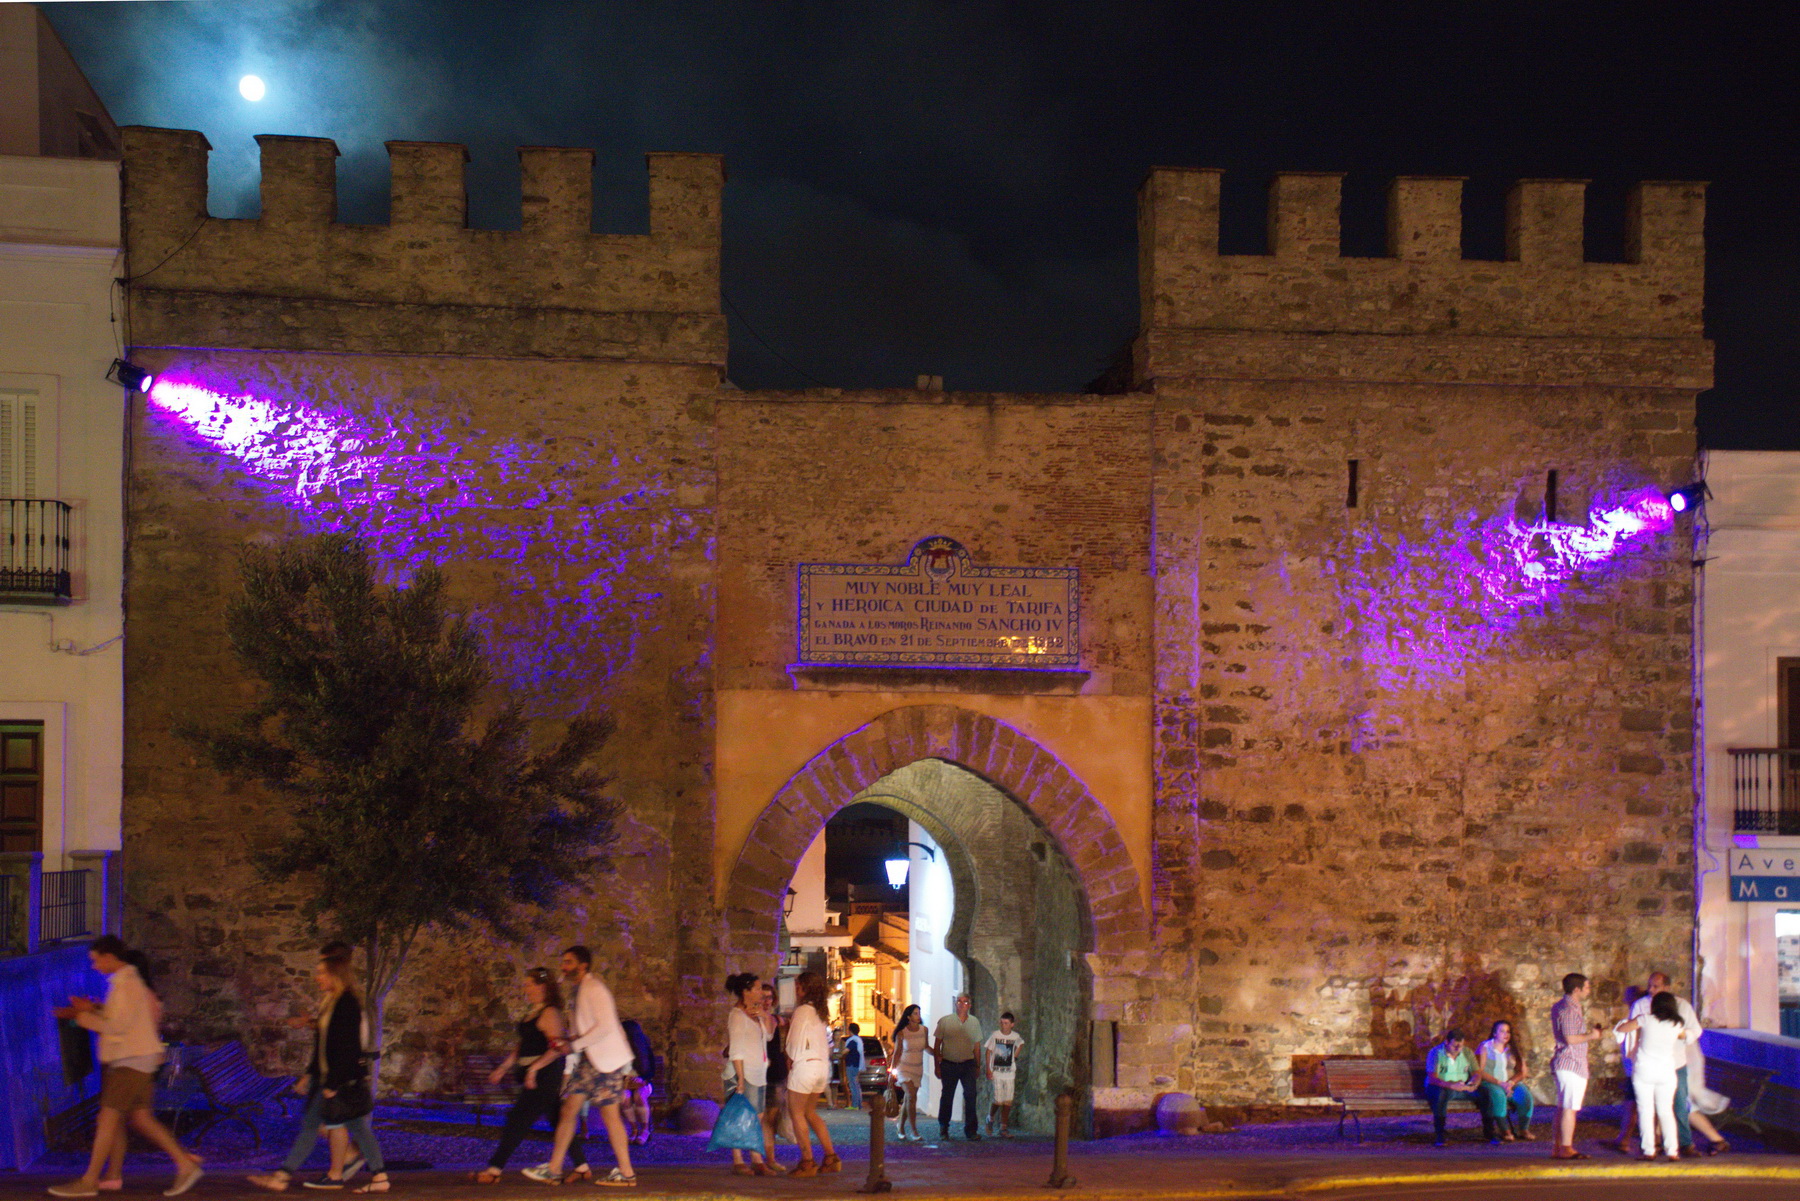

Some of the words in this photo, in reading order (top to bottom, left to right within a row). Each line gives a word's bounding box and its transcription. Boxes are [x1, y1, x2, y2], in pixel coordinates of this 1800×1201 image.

[845, 581, 880, 594] MUY
[886, 582, 941, 595] NOBLE
[948, 582, 983, 595] MUY
[990, 584, 1032, 597] LEAL
[816, 602, 825, 611] Y
[832, 598, 904, 613] HEROICA
[914, 599, 974, 613] CIUDAD
[980, 604, 998, 614] DE
[1006, 601, 1062, 616] TARIFA
[814, 619, 856, 629] GANADA
[868, 621, 886, 629] LOS
[888, 621, 918, 631] MOROS
[920, 616, 972, 632] REINANDO
[977, 618, 1041, 632] SANCHO
[1047, 619, 1063, 632] IV
[815, 636, 830, 645] EL
[834, 633, 878, 647] BRAVO
[881, 637, 896, 645] EN
[900, 634, 913, 646] 21
[917, 637, 933, 646] DE
[936, 634, 1008, 648] SEPTIEMBRE
[1738, 853, 1794, 870] Ave
[1739, 880, 1788, 898] Ma
